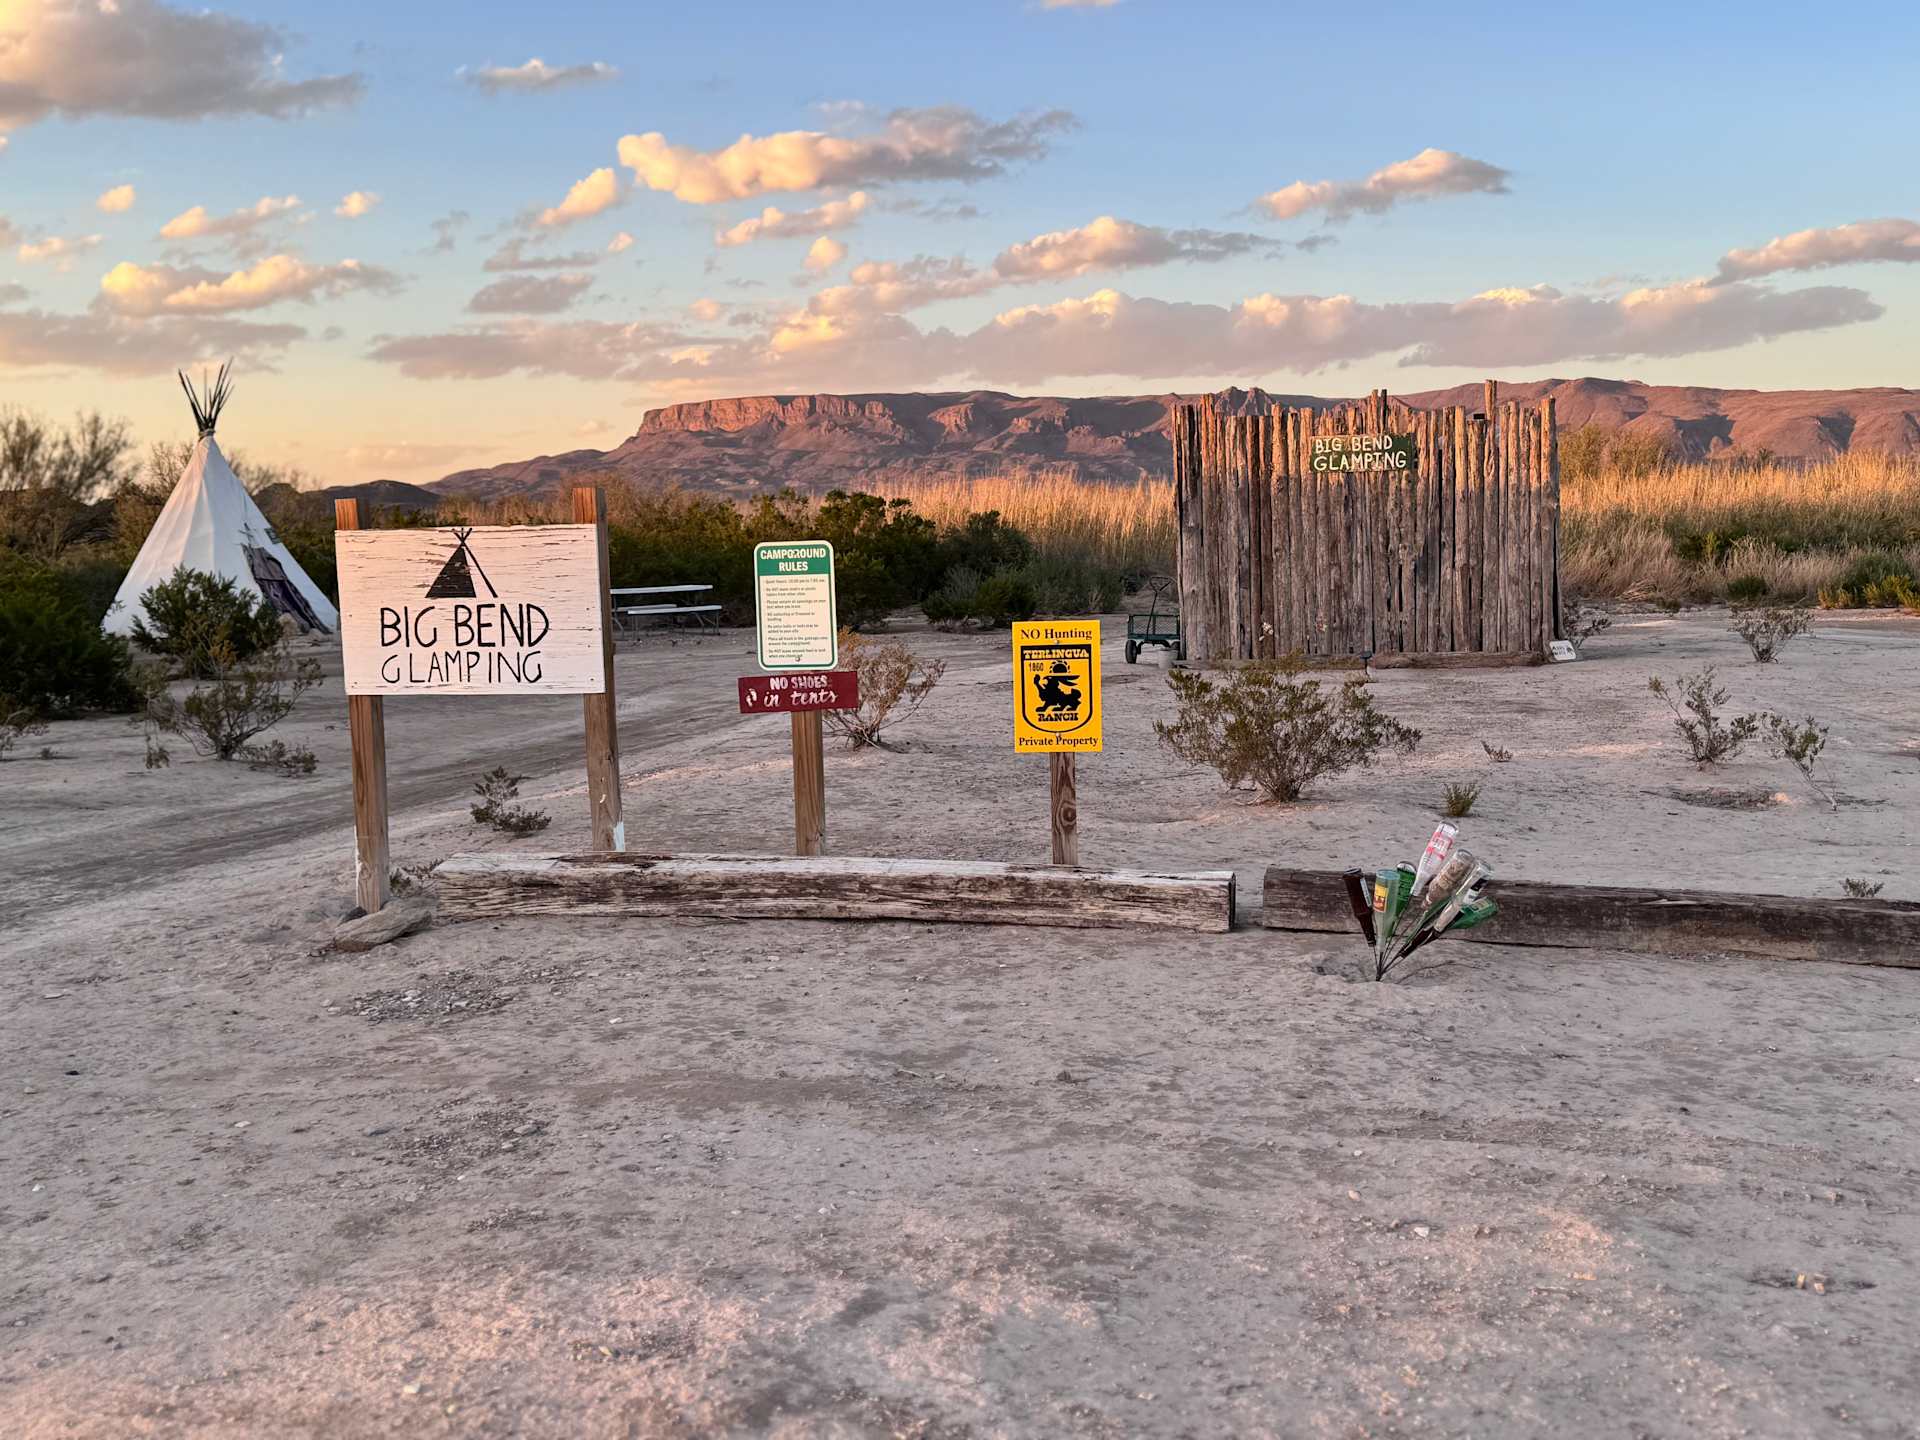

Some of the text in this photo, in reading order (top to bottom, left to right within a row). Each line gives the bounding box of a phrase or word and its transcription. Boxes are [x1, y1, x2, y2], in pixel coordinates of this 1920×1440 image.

[1315, 435, 1393, 454] BIG BEND
[1314, 451, 1407, 471] GLAMPING
[760, 548, 826, 560] CAMPGROUND
[779, 561, 809, 572] RULES
[380, 603, 550, 648] BIG BEND
[1020, 628, 1092, 640] NO Hunting
[1023, 649, 1089, 660] TERLINGUA
[381, 650, 542, 684] GLAMPING
[769, 674, 828, 690] NO SHOES
[763, 689, 839, 708] in tents
[1038, 713, 1079, 722] RANCH
[1018, 735, 1099, 747] Private Property
